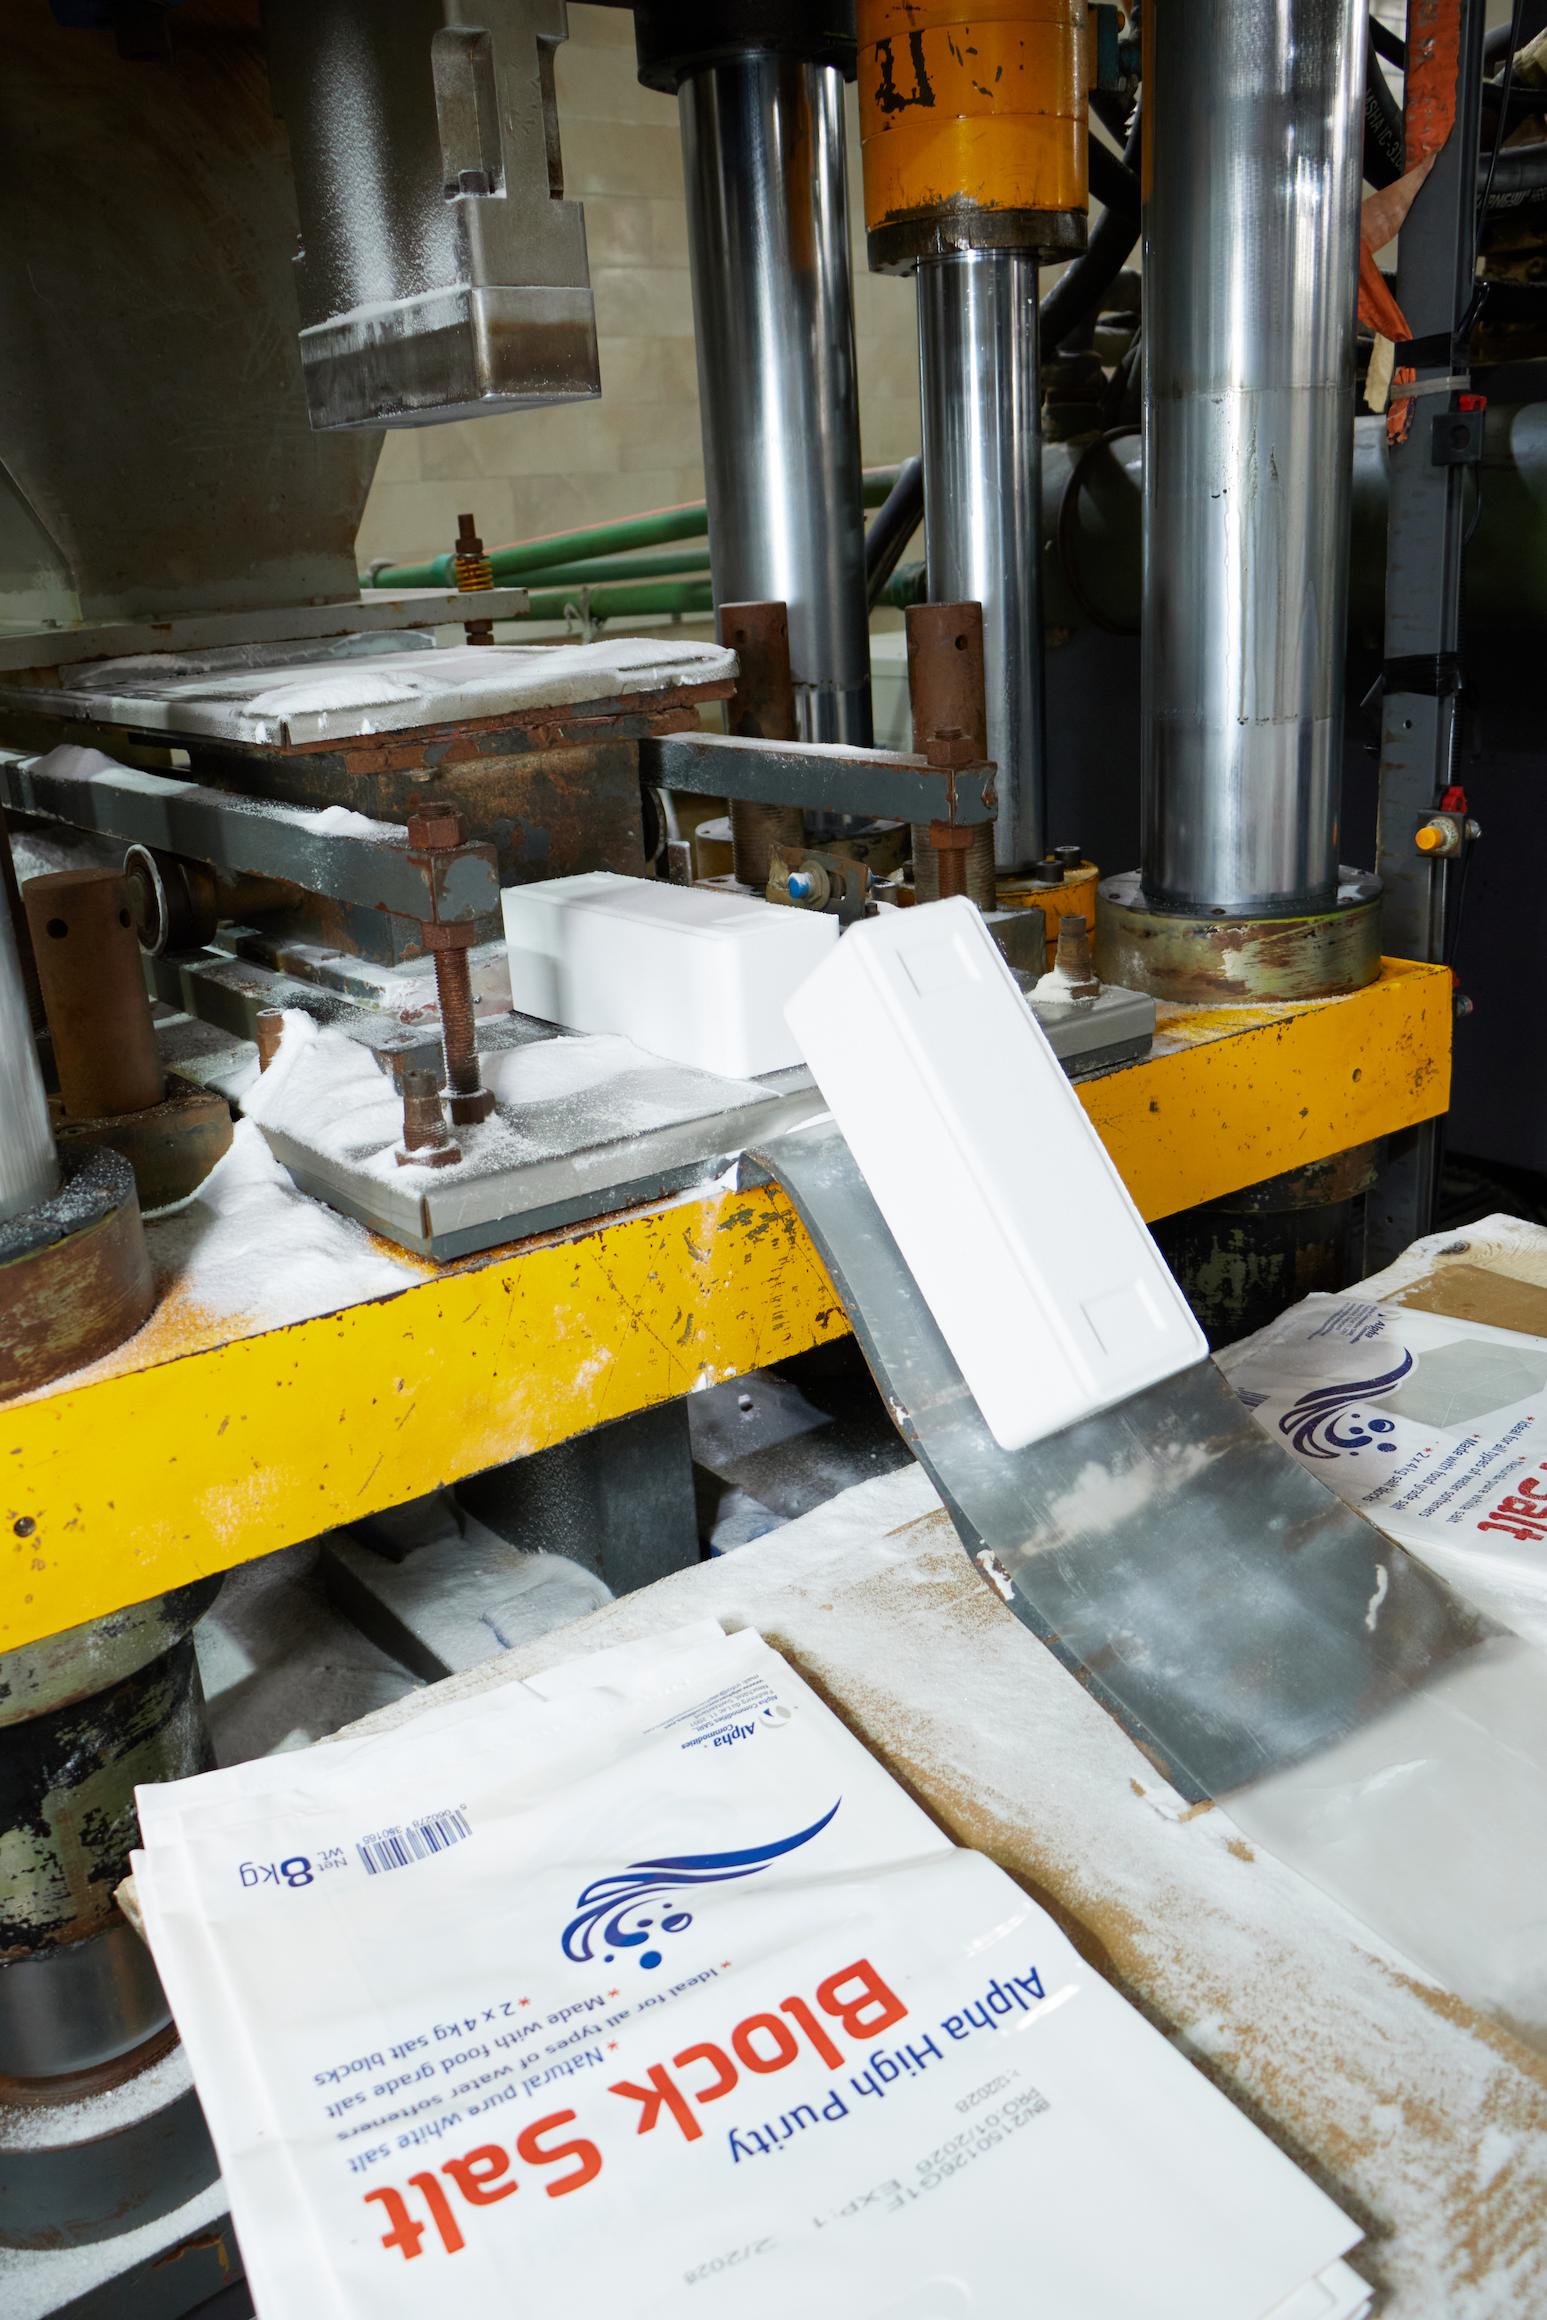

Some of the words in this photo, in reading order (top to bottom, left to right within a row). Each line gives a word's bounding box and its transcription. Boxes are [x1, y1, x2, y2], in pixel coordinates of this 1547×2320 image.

[1365, 1320, 1385, 1338] Alpha
[1509, 1421, 1531, 1436] Ideal
[1452, 1438, 1478, 1455] Made
[1492, 1444, 1507, 1453] all
[1500, 1435, 1518, 1444] for
[1438, 1456, 1458, 1470] with
[1476, 1452, 1499, 1468] types
[1422, 1471, 1446, 1485] food
[1468, 1468, 1482, 1476] of
[1492, 1461, 1524, 1480] Natural
[1383, 1476, 1402, 1487] salt
[1450, 1475, 1474, 1491] water
[1478, 1481, 1498, 1493] pure
[1403, 1484, 1427, 1500] grade
[1390, 1500, 1408, 1510] salt
[1418, 1491, 1454, 1517] softeners
[1446, 1511, 1465, 1523] salt
[757, 1694, 777, 1706] Alpha
[713, 1702, 758, 1724] Commodities
[682, 1724, 733, 1749] Commodities
[714, 1722, 754, 1746] Alpha
[318, 1848, 343, 1860] wt.
[240, 1857, 314, 1887] 8kg
[318, 1858, 347, 1871] Net
[668, 1968, 718, 1996] Ideal
[500, 2002, 515, 2016] 2
[547, 1996, 605, 2024] Made
[638, 1995, 666, 2012] for
[941, 1967, 1045, 2040] Alpha
[464, 2019, 476, 2031] 4
[482, 2009, 495, 2022] x
[606, 2010, 630, 2027] all
[494, 2022, 542, 2048] with
[545, 2025, 602, 2054] types
[390, 2036, 428, 2059] salt
[608, 1958, 908, 2142] Block
[440, 2044, 490, 2074] food
[520, 2053, 539, 2070] of
[850, 2034, 944, 2097] High
[314, 2053, 386, 2086] blocks
[374, 2062, 435, 2096] grade
[522, 2047, 604, 2096] Natural
[452, 2066, 514, 2098] water
[326, 2092, 366, 2118] salt
[467, 2084, 517, 2116] pure
[337, 2096, 443, 2140] softeners
[728, 2090, 849, 2163] Purity
[398, 2112, 462, 2148] white
[348, 2144, 390, 2173] salt
[364, 2109, 602, 2260] Salt
